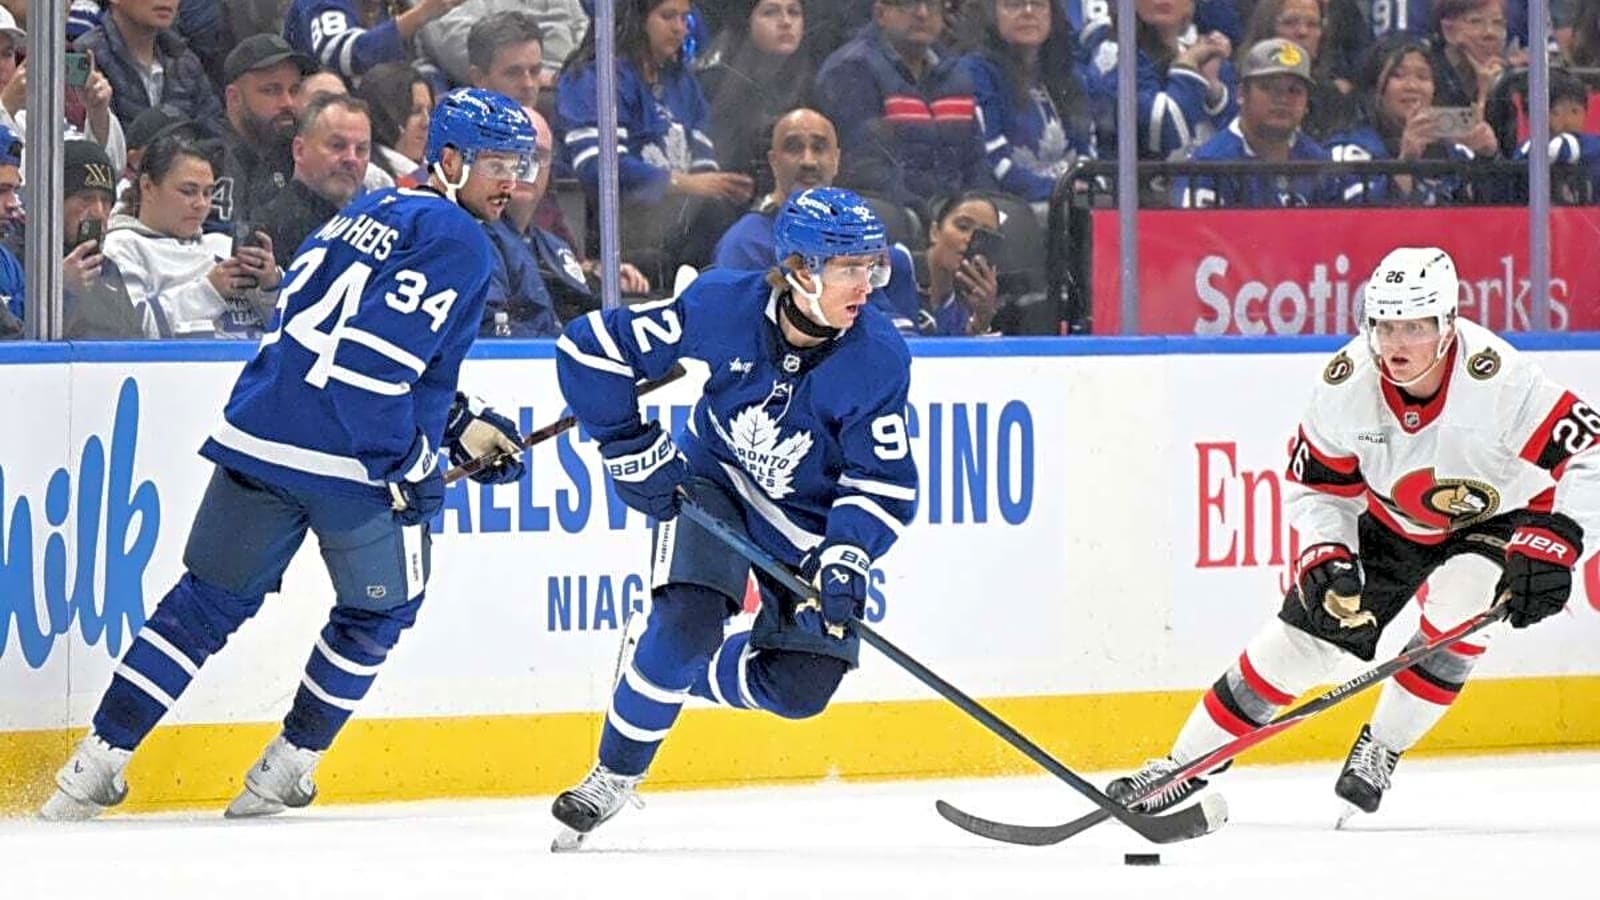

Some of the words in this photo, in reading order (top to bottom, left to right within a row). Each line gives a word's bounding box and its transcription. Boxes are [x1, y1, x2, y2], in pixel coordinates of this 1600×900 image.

[384, 269, 459, 333] 34
[1385, 270, 1406, 284] 26
[1552, 401, 1600, 454] 26
[547, 573, 645, 632] NIAG
